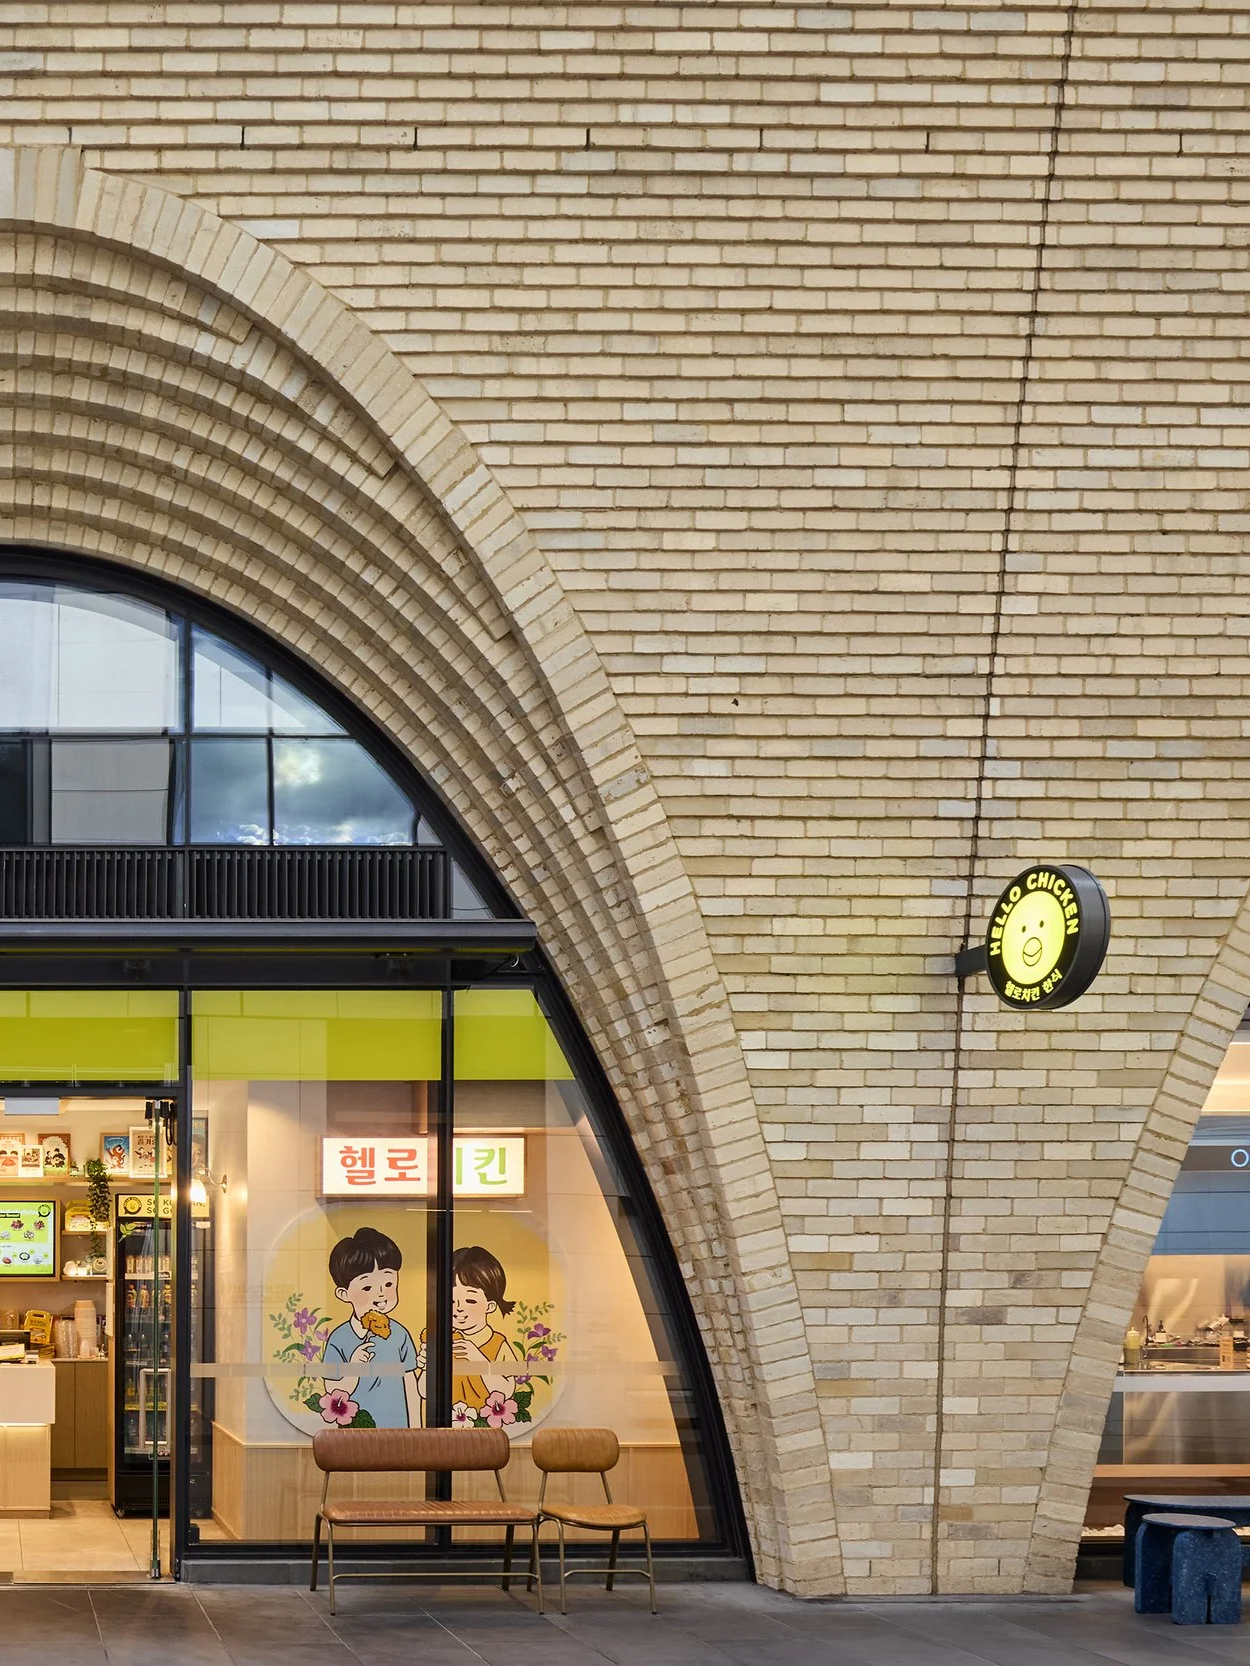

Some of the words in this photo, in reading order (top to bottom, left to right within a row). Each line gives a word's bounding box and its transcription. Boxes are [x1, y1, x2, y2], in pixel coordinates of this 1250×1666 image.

[989, 885, 1022, 956] HELLO
[1026, 871, 1079, 935] CHICKEN
[1004, 980, 1041, 1002] 헬로치킨
